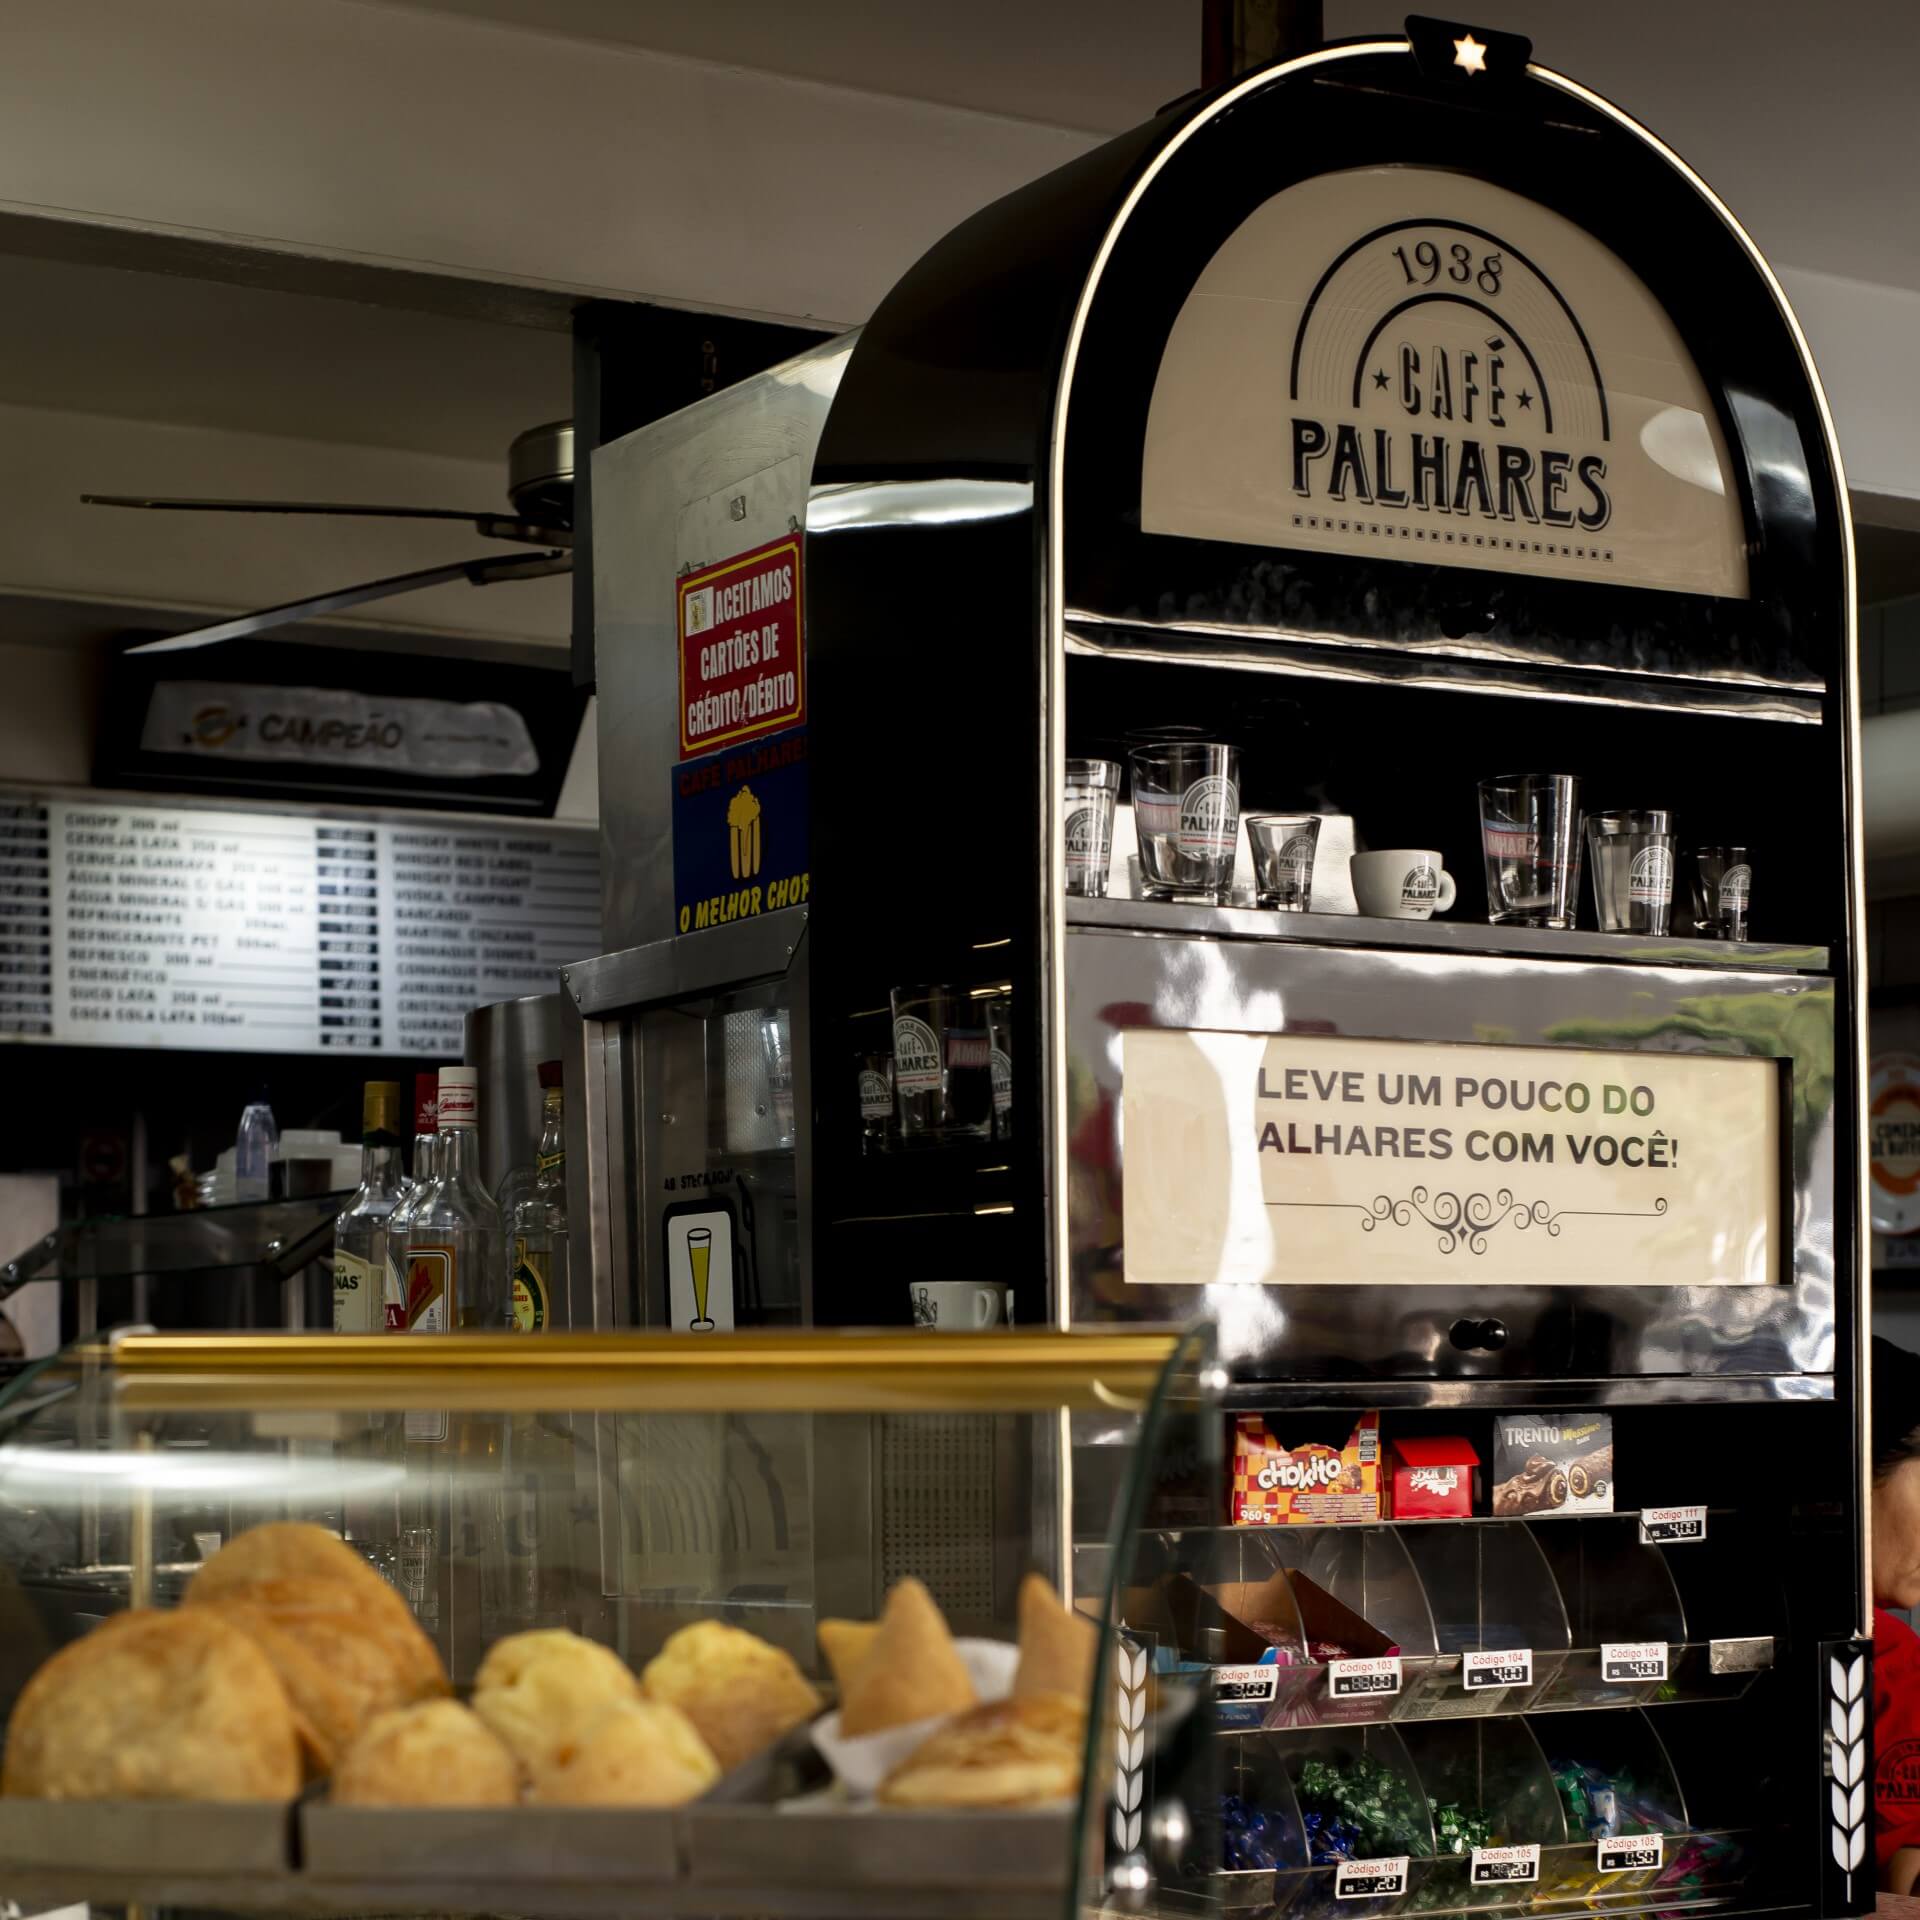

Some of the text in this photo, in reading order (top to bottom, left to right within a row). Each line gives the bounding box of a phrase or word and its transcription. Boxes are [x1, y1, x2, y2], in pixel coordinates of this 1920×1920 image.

[1392, 241, 1503, 296] 1938
[1399, 335, 1506, 428] CAFÉ
[1289, 418, 1612, 532] PALHARES
[715, 564, 792, 625] ACEITAMOS
[700, 622, 779, 681] CARTÕES DE
[688, 671, 796, 737] CRÉDITO/DÉBITO
[259, 713, 403, 750] CAMPEÃO
[65, 813, 119, 828] CHOPP
[65, 832, 137, 848] CERVEJA
[142, 835, 180, 848] LATA
[65, 851, 137, 867] CERVEJA
[144, 856, 215, 871] GARRAFA
[118, 873, 187, 889] MINERAL
[118, 892, 187, 908] MINERAL
[67, 907, 181, 925] REFRIGERANTE
[680, 903, 690, 932] O
[695, 886, 761, 929] MELHOR
[67, 928, 185, 945] REFRIGERANTE
[67, 947, 149, 963] REFRESCO
[68, 966, 167, 983] ENERGÉTICO
[69, 986, 112, 1001] SUCO
[117, 987, 156, 1002] LATA
[70, 1006, 110, 1021] COCA
[116, 1007, 155, 1022] COLA
[160, 1009, 195, 1024] LATA
[1257, 1066, 1655, 1118] LEVE UM POUCO DO
[1465, 1129, 1555, 1164] COM
[1567, 1130, 1678, 1168] VOCÊ!
[1505, 1427, 1559, 1448] TRENTO
[1240, 1509, 1272, 1523] 960 g
[1685, 1509, 1697, 1517] 111
[1669, 1521, 1697, 1537] 4,00
[1508, 1653, 1523, 1663] 104
[1645, 1648, 1659, 1657] 104
[1377, 1660, 1392, 1670] 103
[1630, 1661, 1658, 1677] 4,00
[1254, 1669, 1269, 1678] 103
[1492, 1666, 1522, 1683] 4,00
[1640, 1837, 1655, 1846] 105
[1517, 1849, 1531, 1858] 105
[1384, 1862, 1399, 1873] 101
